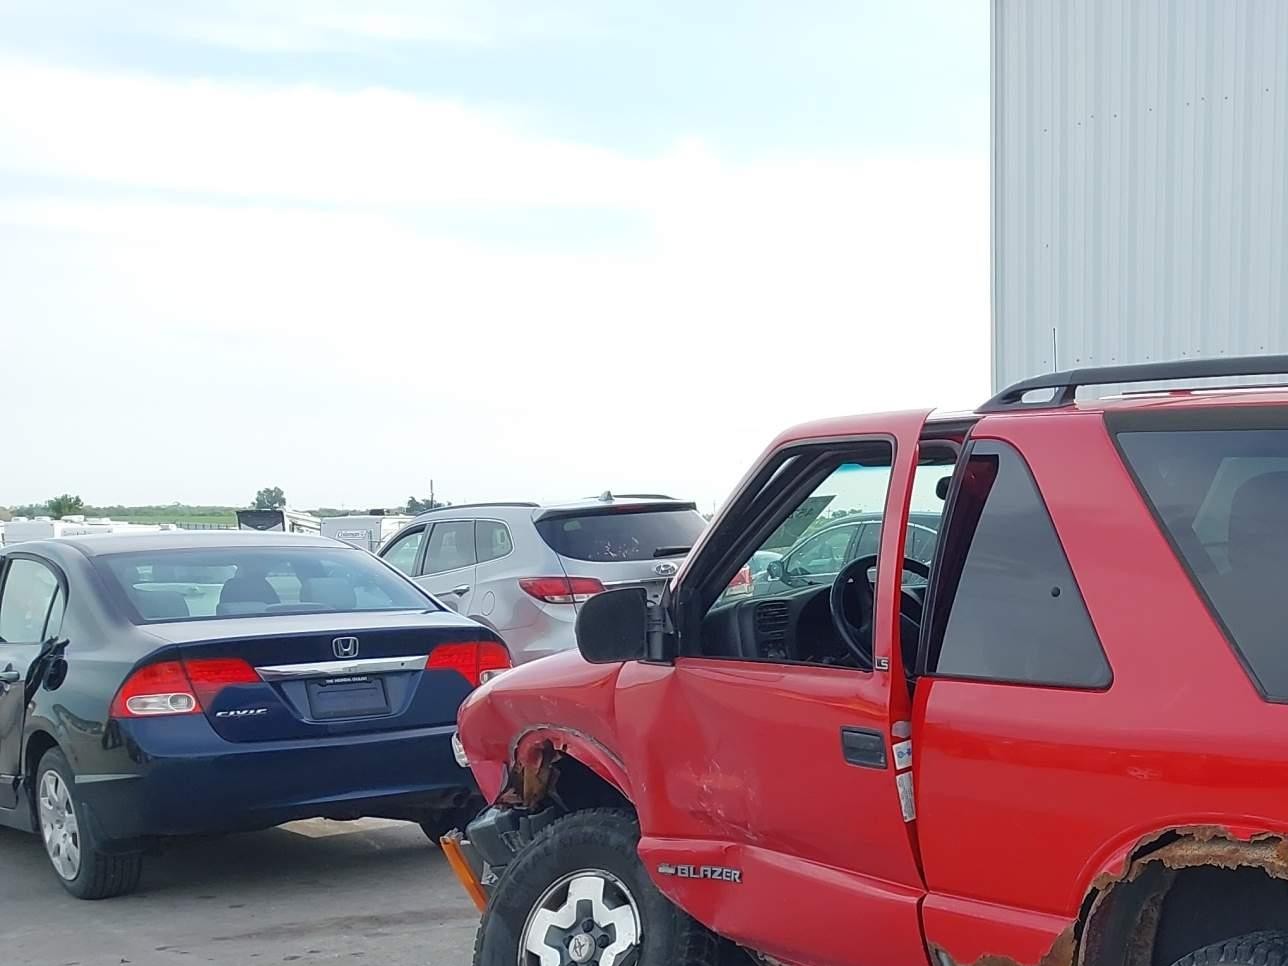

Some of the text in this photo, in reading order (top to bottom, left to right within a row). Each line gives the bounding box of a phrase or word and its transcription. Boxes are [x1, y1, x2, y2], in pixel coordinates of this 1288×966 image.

[875, 659, 889, 670] LS
[215, 708, 268, 718] CIVIC
[677, 864, 742, 883] BLAZER
